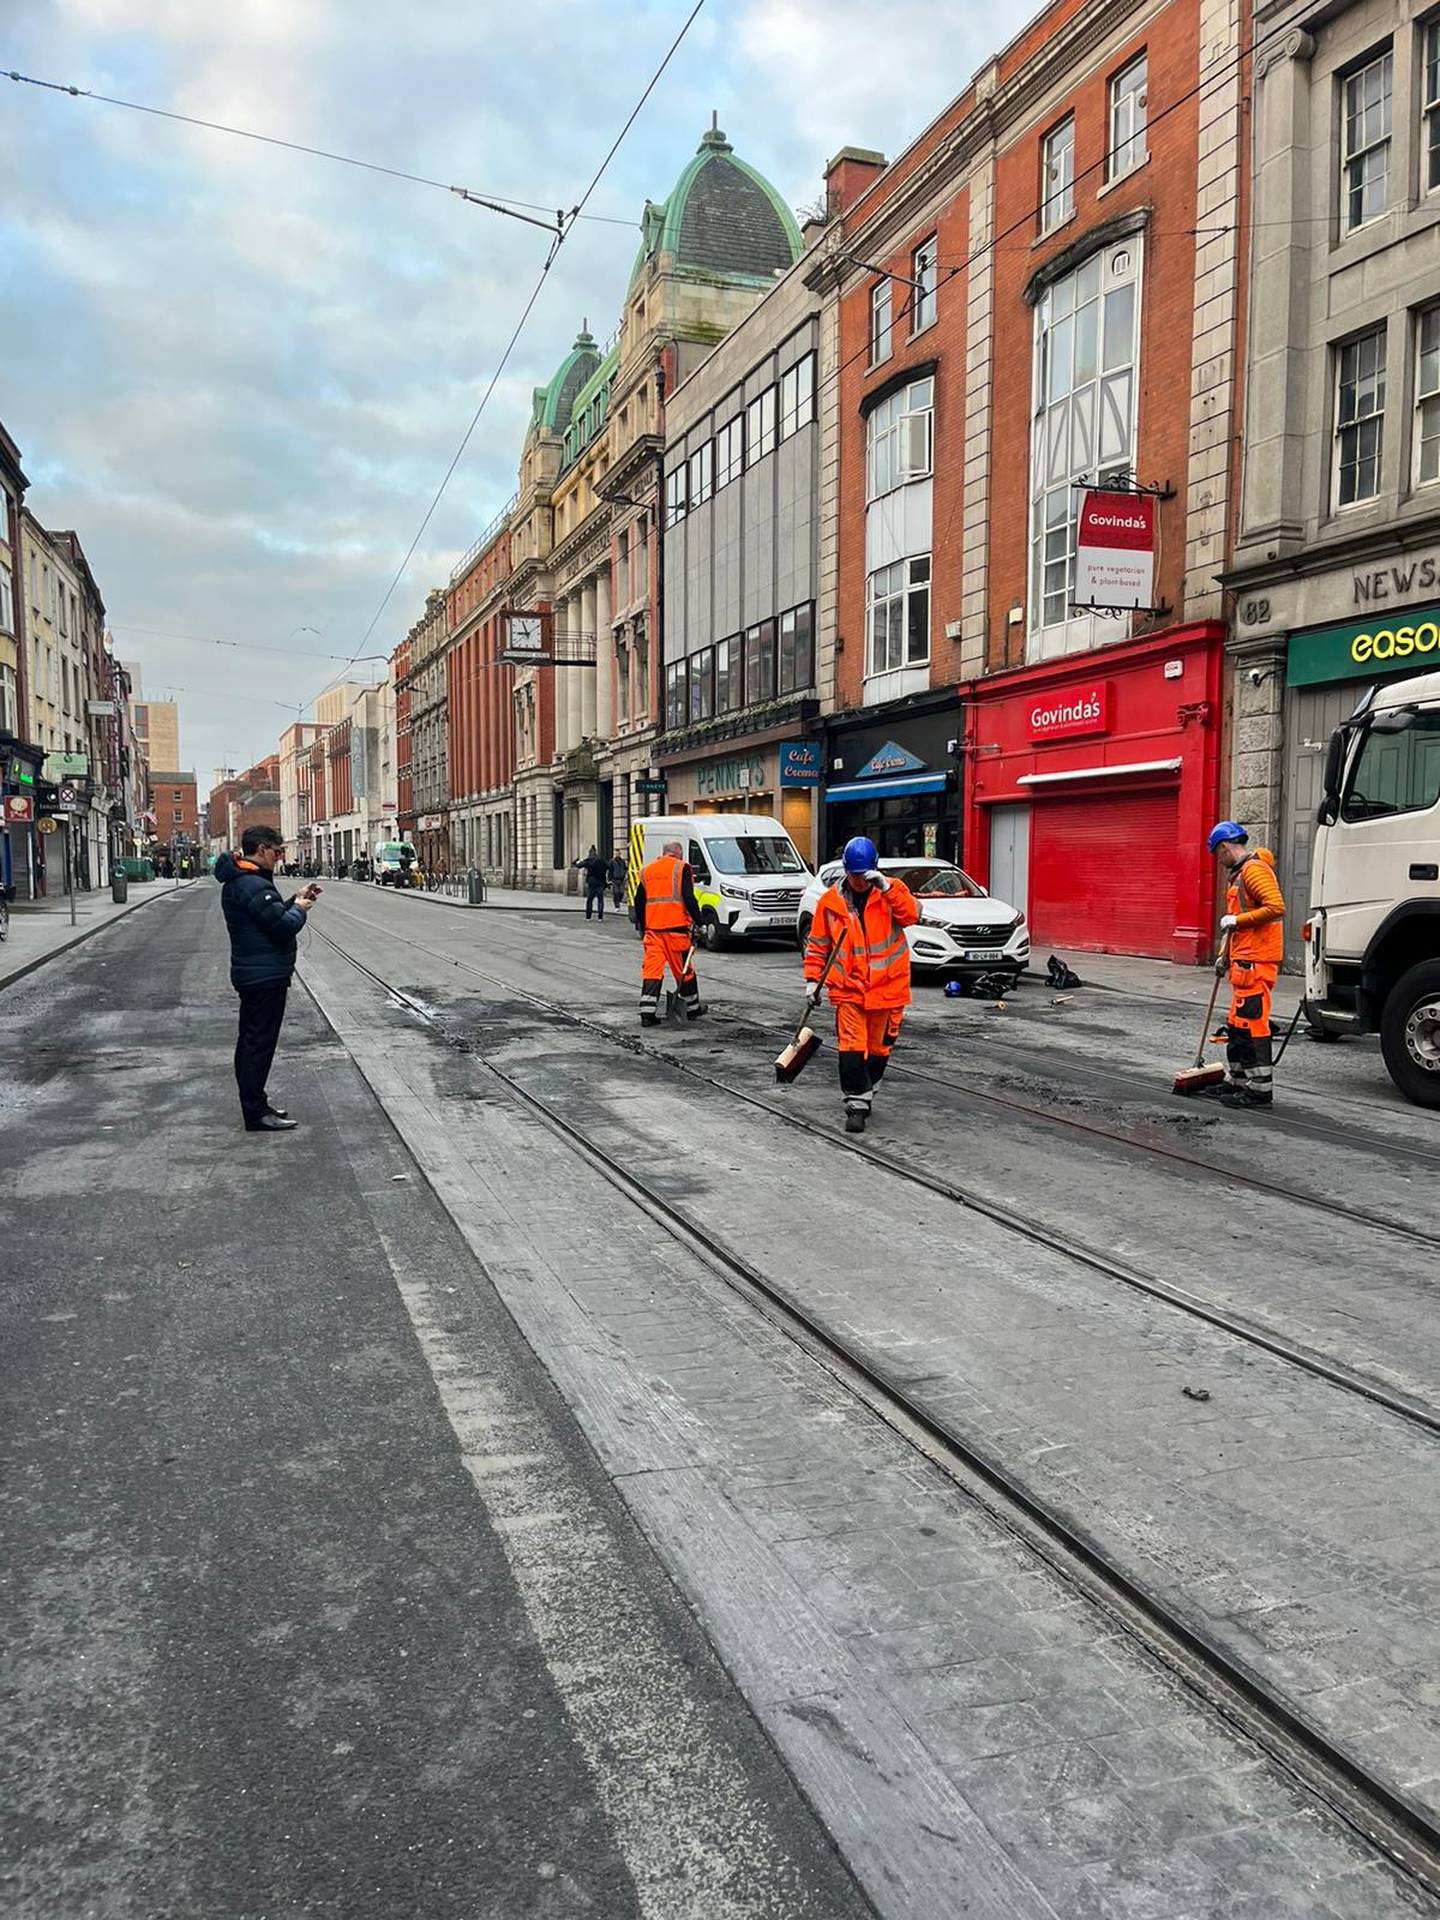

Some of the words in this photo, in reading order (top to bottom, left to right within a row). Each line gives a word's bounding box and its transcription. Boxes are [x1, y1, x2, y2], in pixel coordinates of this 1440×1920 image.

[1089, 513, 1146, 529] Govinda's
[1088, 565, 1104, 573] pure
[1107, 566, 1145, 575] vegetarian
[1091, 576, 1097, 584] &
[1354, 557, 1440, 603] NEWS
[1243, 600, 1271, 626] 82
[1351, 622, 1440, 662] easo
[1031, 692, 1101, 728] Govinda's
